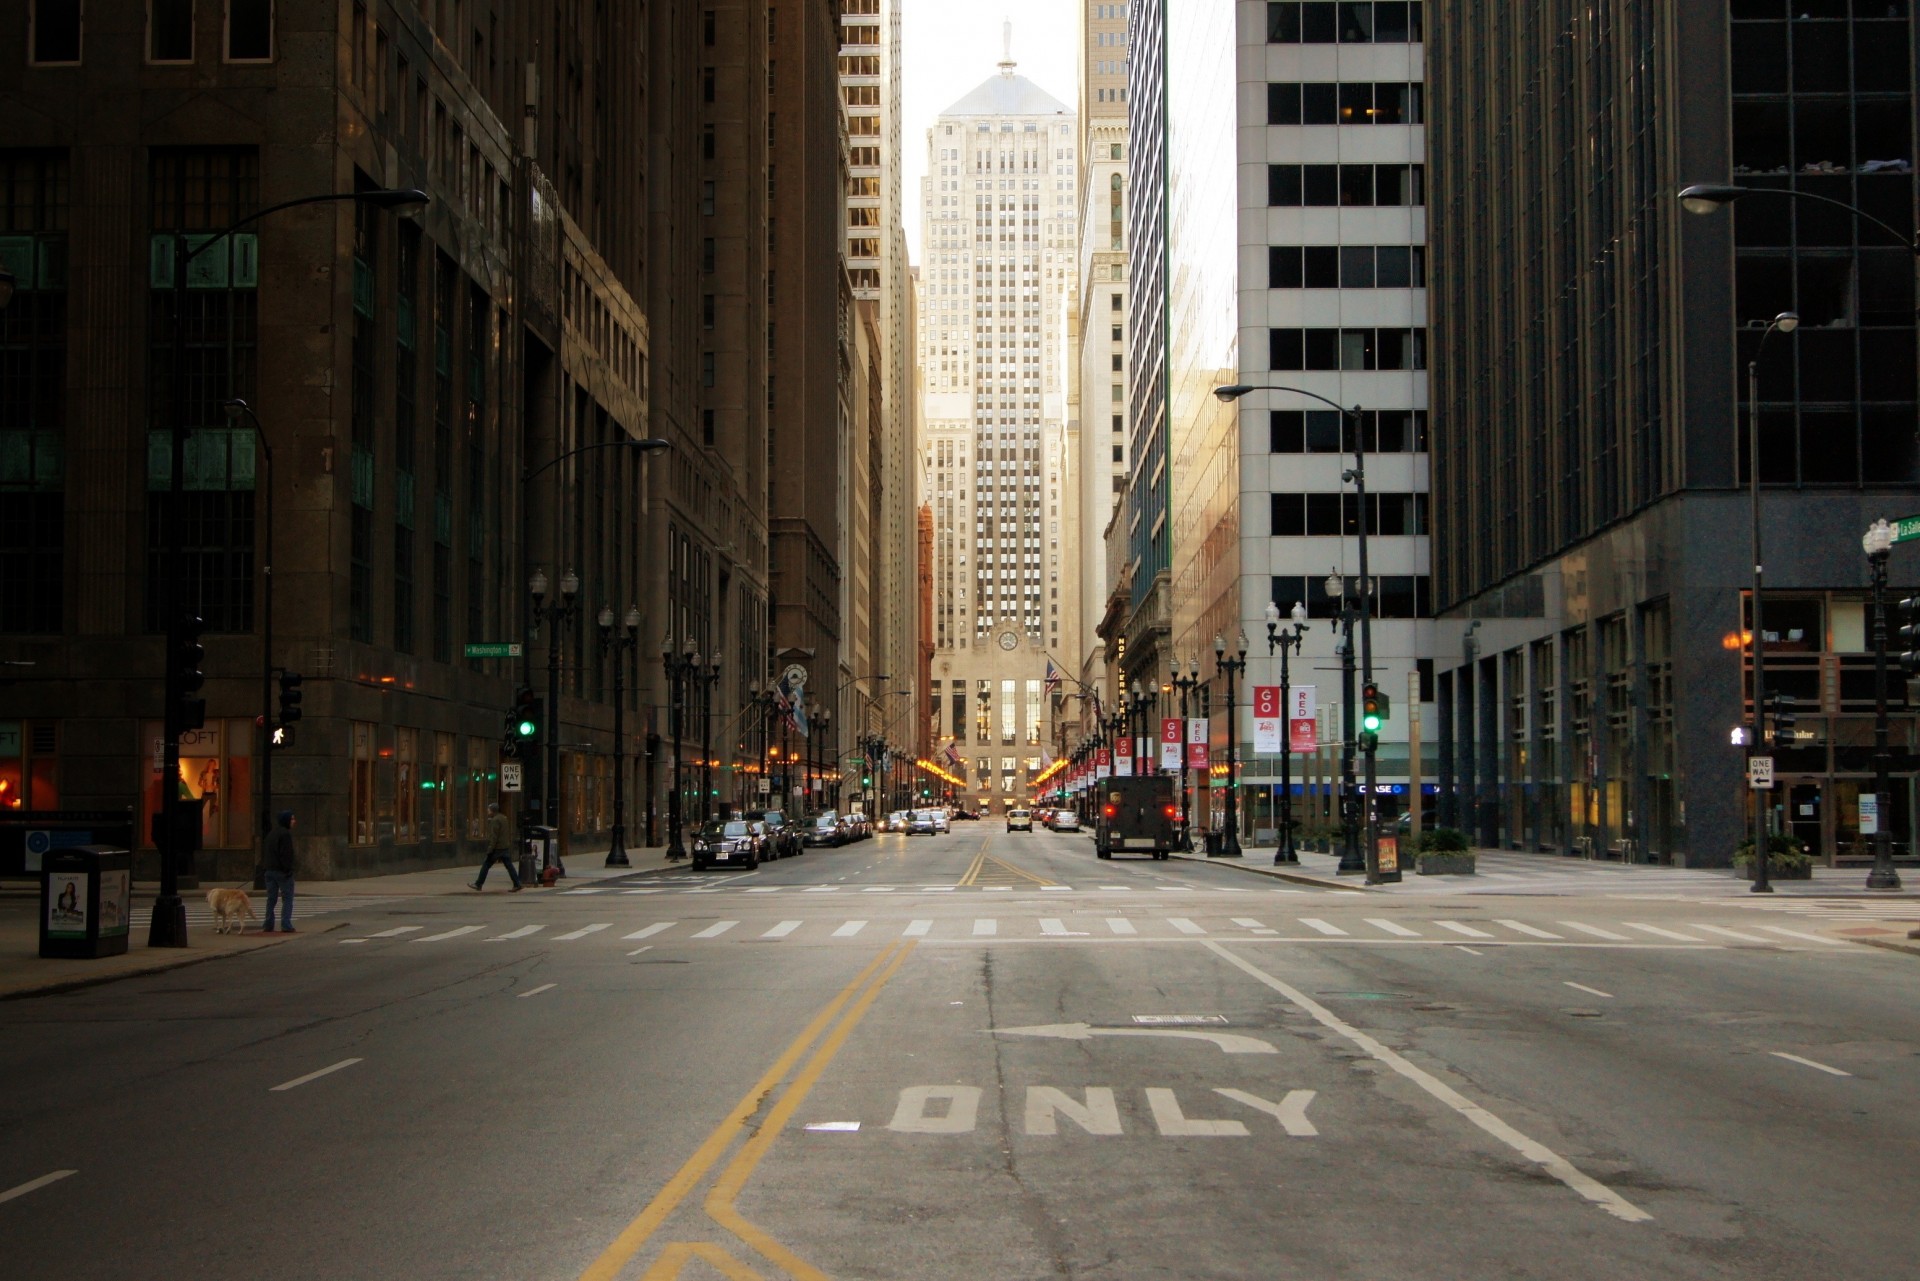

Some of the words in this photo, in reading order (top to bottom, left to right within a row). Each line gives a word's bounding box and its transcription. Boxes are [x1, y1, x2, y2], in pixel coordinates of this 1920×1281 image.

[471, 646, 501, 656] Washington
[1261, 690, 1272, 713] GO
[1298, 692, 1307, 717] RED
[1167, 722, 1176, 739] GO
[1120, 740, 1127, 754] GO
[1100, 752, 1106, 764] GO
[1752, 760, 1770, 768] ONE
[503, 773, 520, 781] WAY
[1752, 768, 1770, 776] WAY
[1359, 785, 1392, 793] CSE
[885, 1085, 1319, 1136] ONLY
